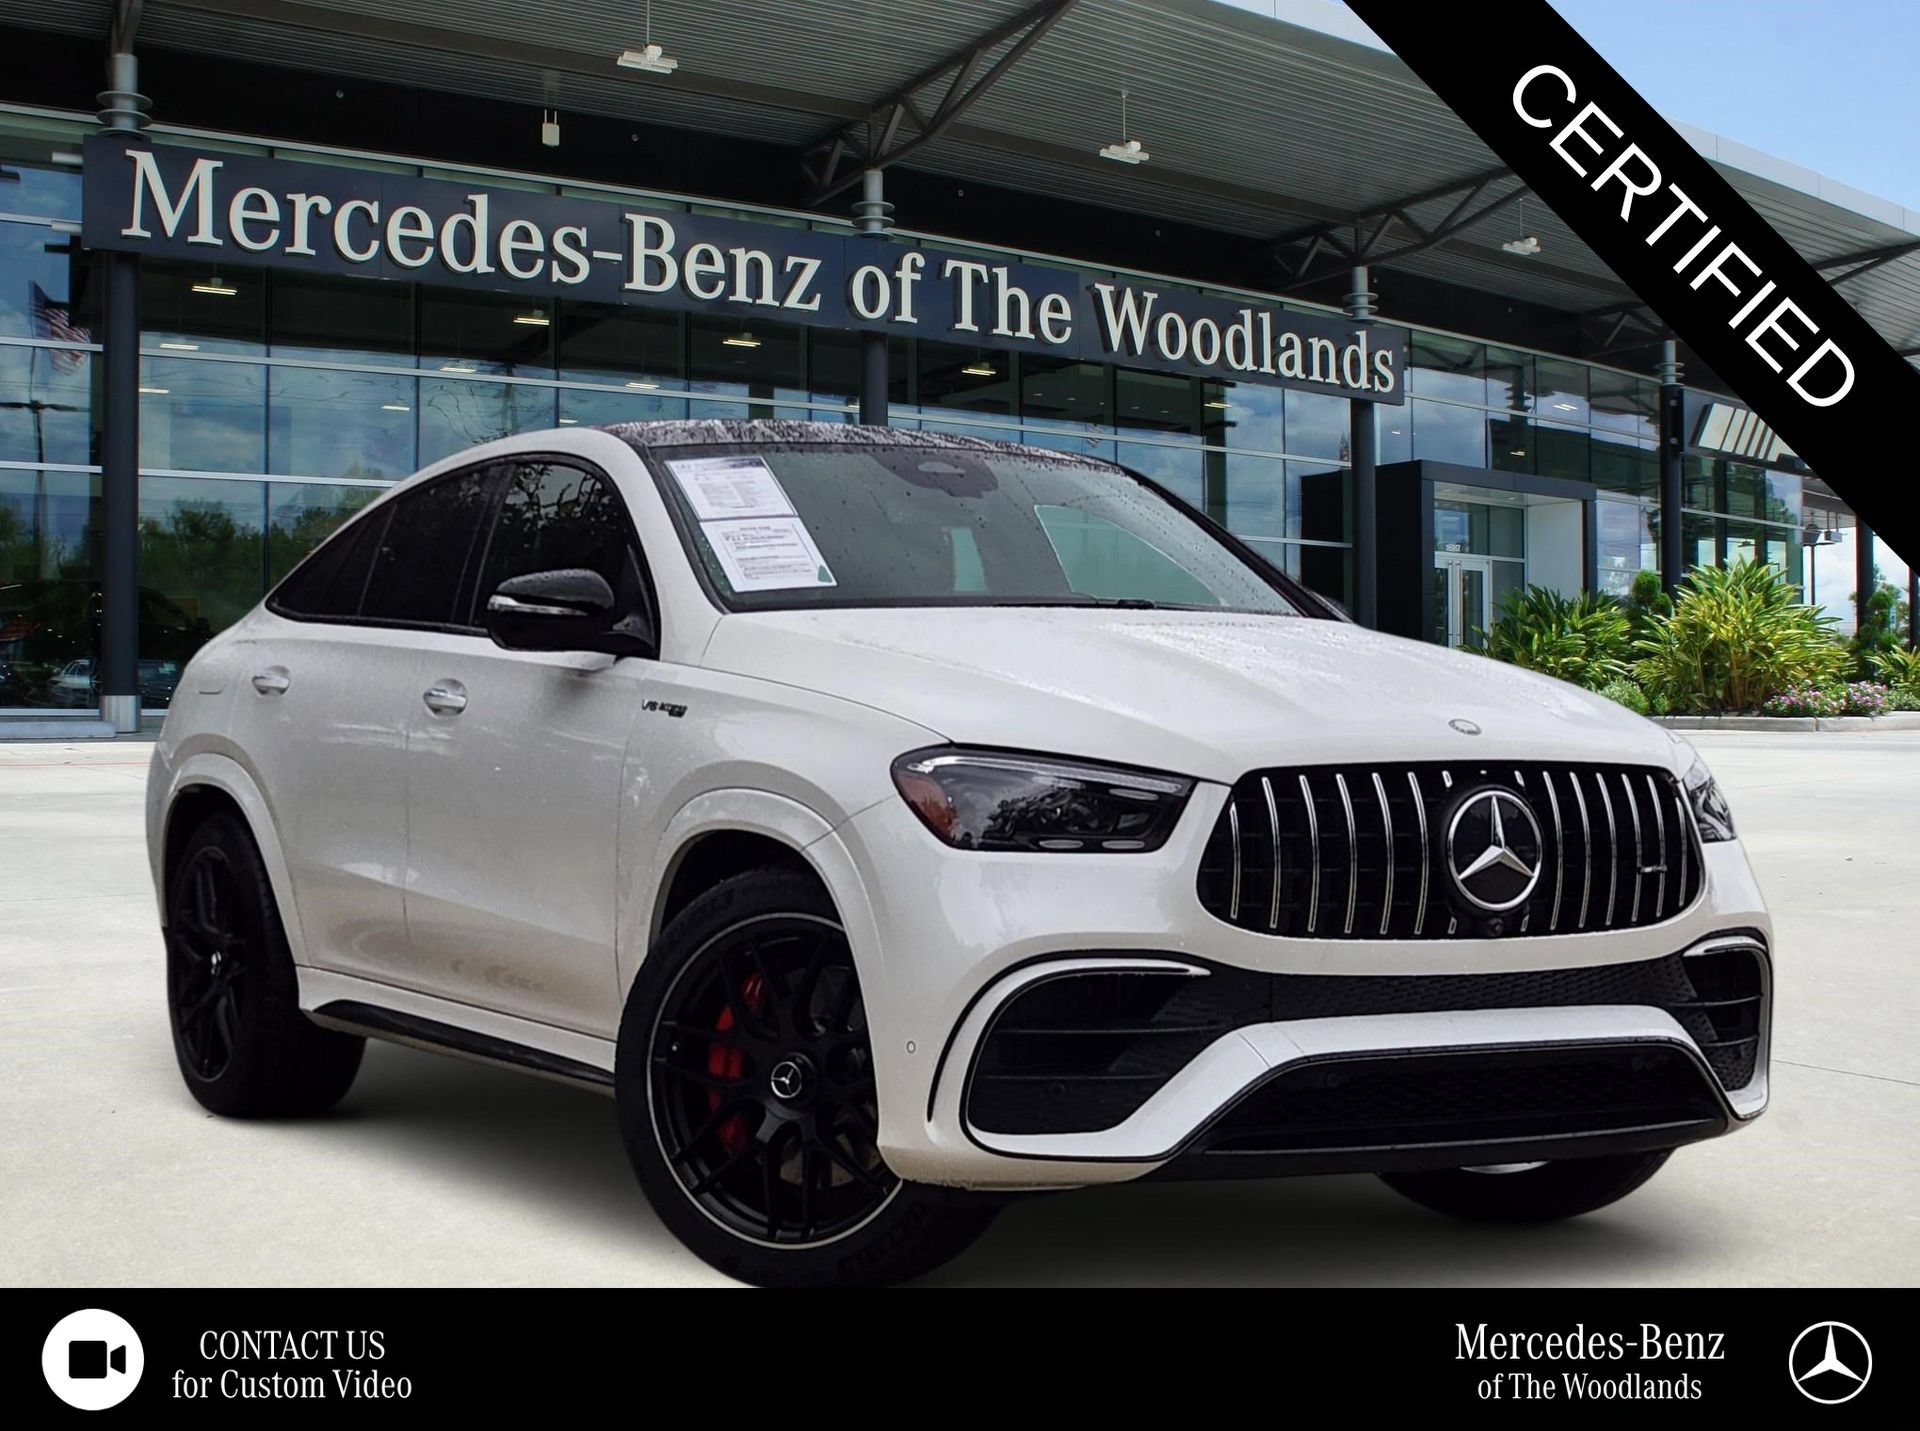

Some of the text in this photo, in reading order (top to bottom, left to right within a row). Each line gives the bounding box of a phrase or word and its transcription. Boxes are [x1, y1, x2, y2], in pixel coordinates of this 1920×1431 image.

[122, 148, 1396, 395] Mercedes-Benz of The Woodlands
